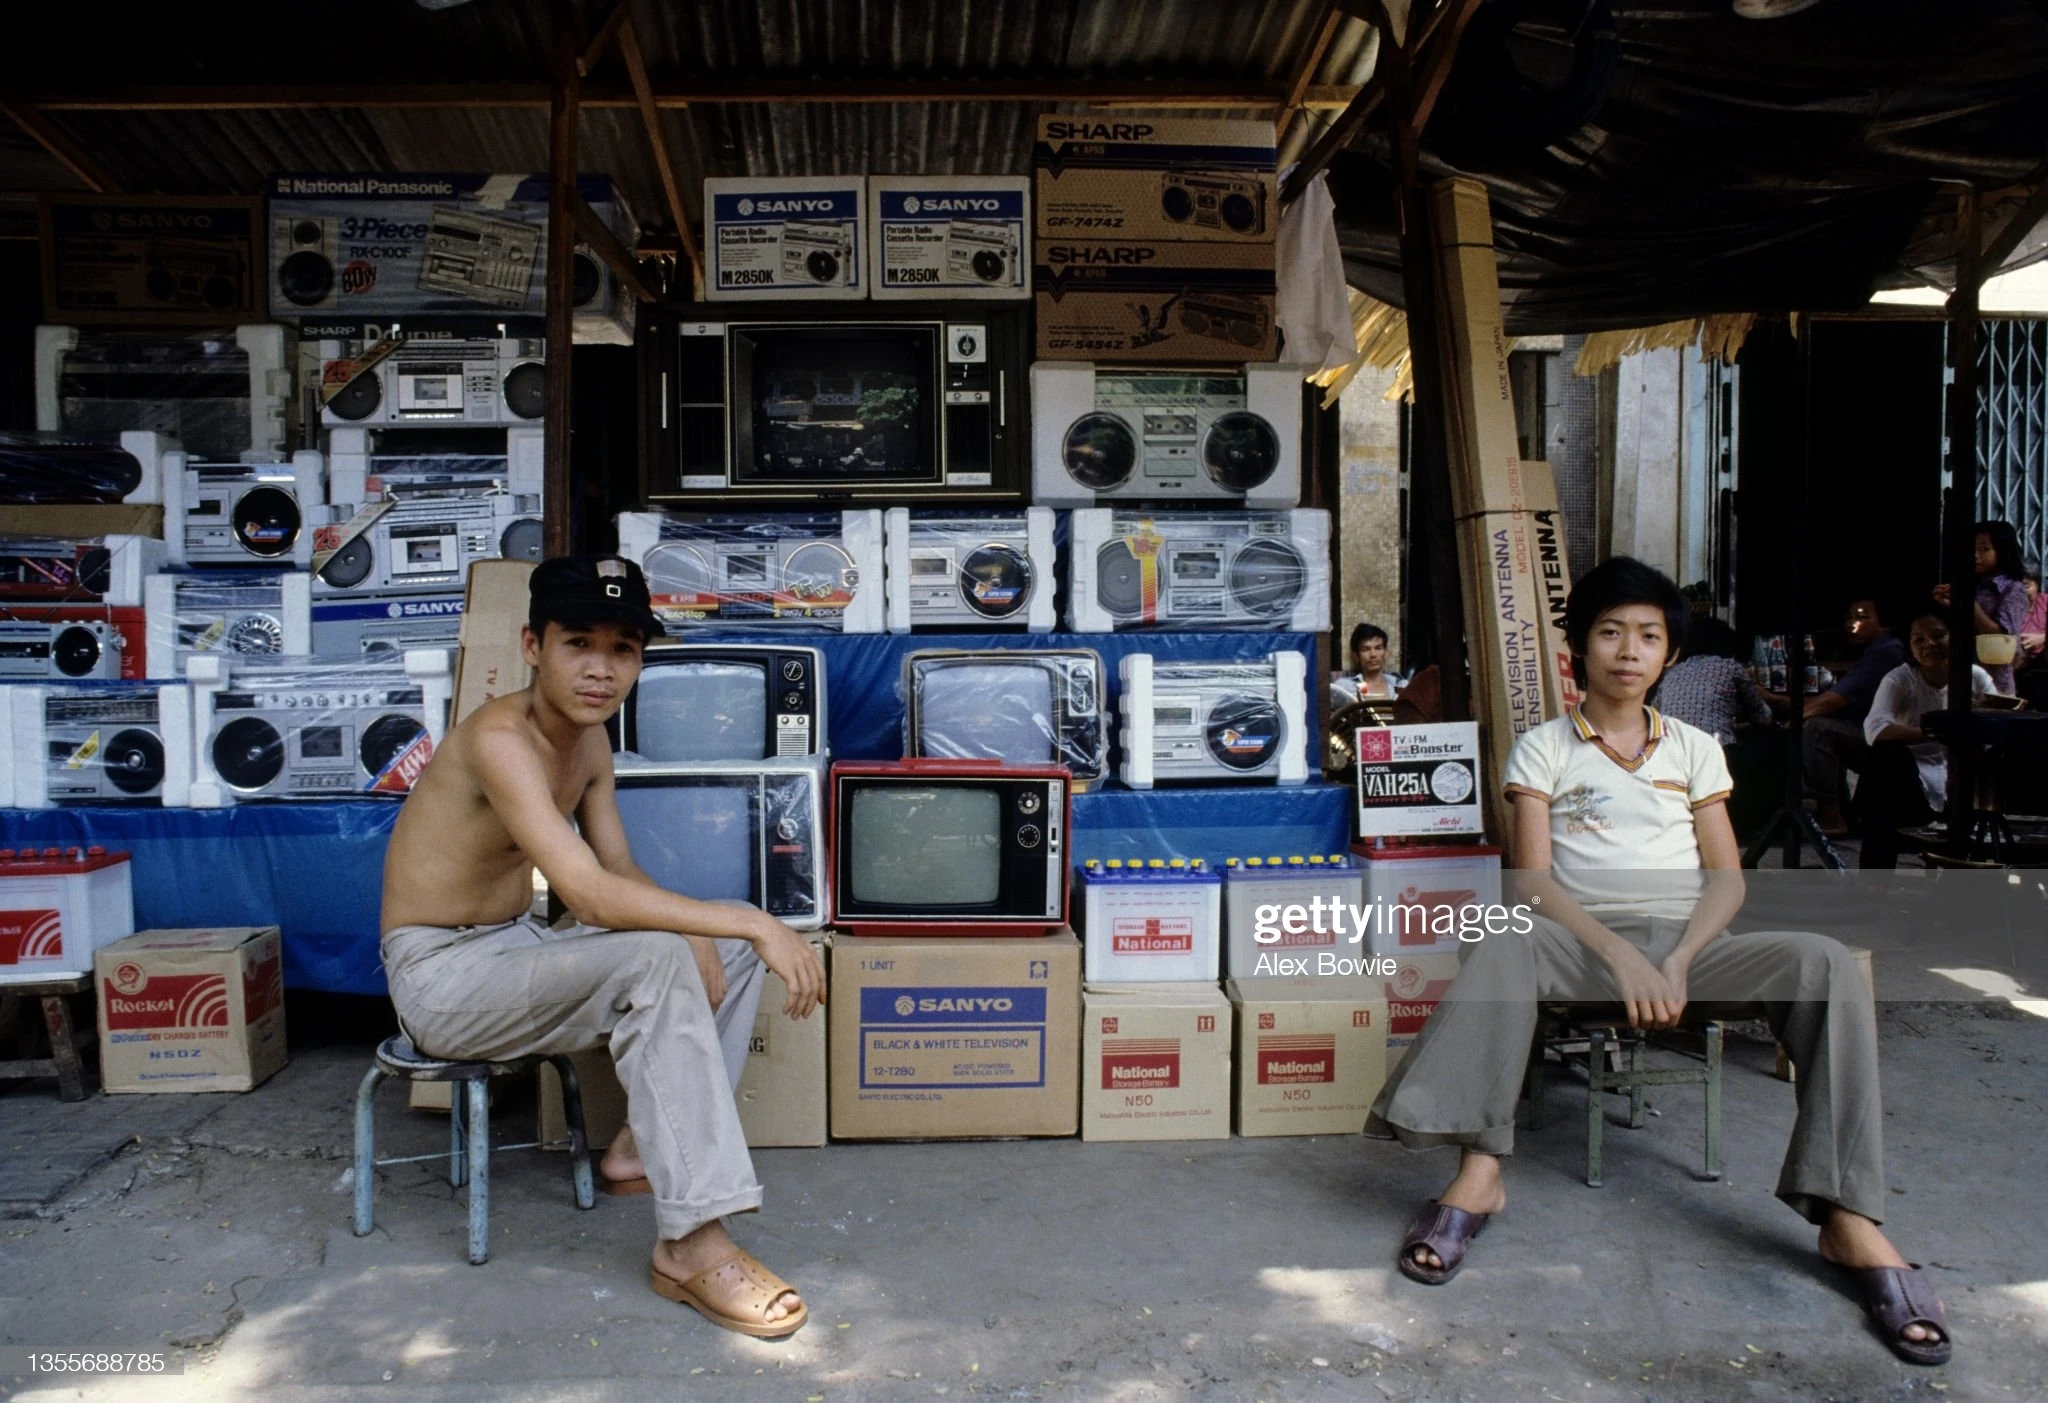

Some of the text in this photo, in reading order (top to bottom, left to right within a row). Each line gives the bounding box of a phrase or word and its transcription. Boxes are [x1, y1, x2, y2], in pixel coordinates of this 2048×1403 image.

[1046, 122, 1154, 140] SHARP
[293, 179, 453, 195] National Panasonic
[757, 199, 834, 212] SANYO
[923, 199, 1000, 212] SANYO
[117, 213, 215, 228] SANYO
[1047, 217, 1124, 228] GF-7474Z
[342, 217, 429, 239] 3-Piece
[1048, 247, 1155, 264] SHARP
[722, 269, 775, 284] M 2850K
[887, 268, 940, 282] M 2850K
[303, 326, 356, 336] SHARP
[1498, 360, 1505, 370] IN
[1515, 526, 1528, 574] MODEL
[1534, 509, 1568, 632] ANTENNA
[1494, 529, 1527, 740] ELEVISION ANTENNA
[1520, 619, 1541, 730] ENSIBILITY
[1393, 735, 1427, 744] TV FM
[1410, 744, 1463, 755] Booster
[1118, 937, 1187, 950] National
[861, 961, 895, 970] 1 UNIT
[111, 999, 174, 1014] Rocket
[919, 998, 1013, 1012] SANYO
[873, 1038, 1028, 1050] BLACK & WHITE TELEVISION
[1112, 1065, 1170, 1079] National
[1267, 1061, 1325, 1074] National
[1125, 1094, 1153, 1106] N50
[1283, 1090, 1311, 1101] N50
